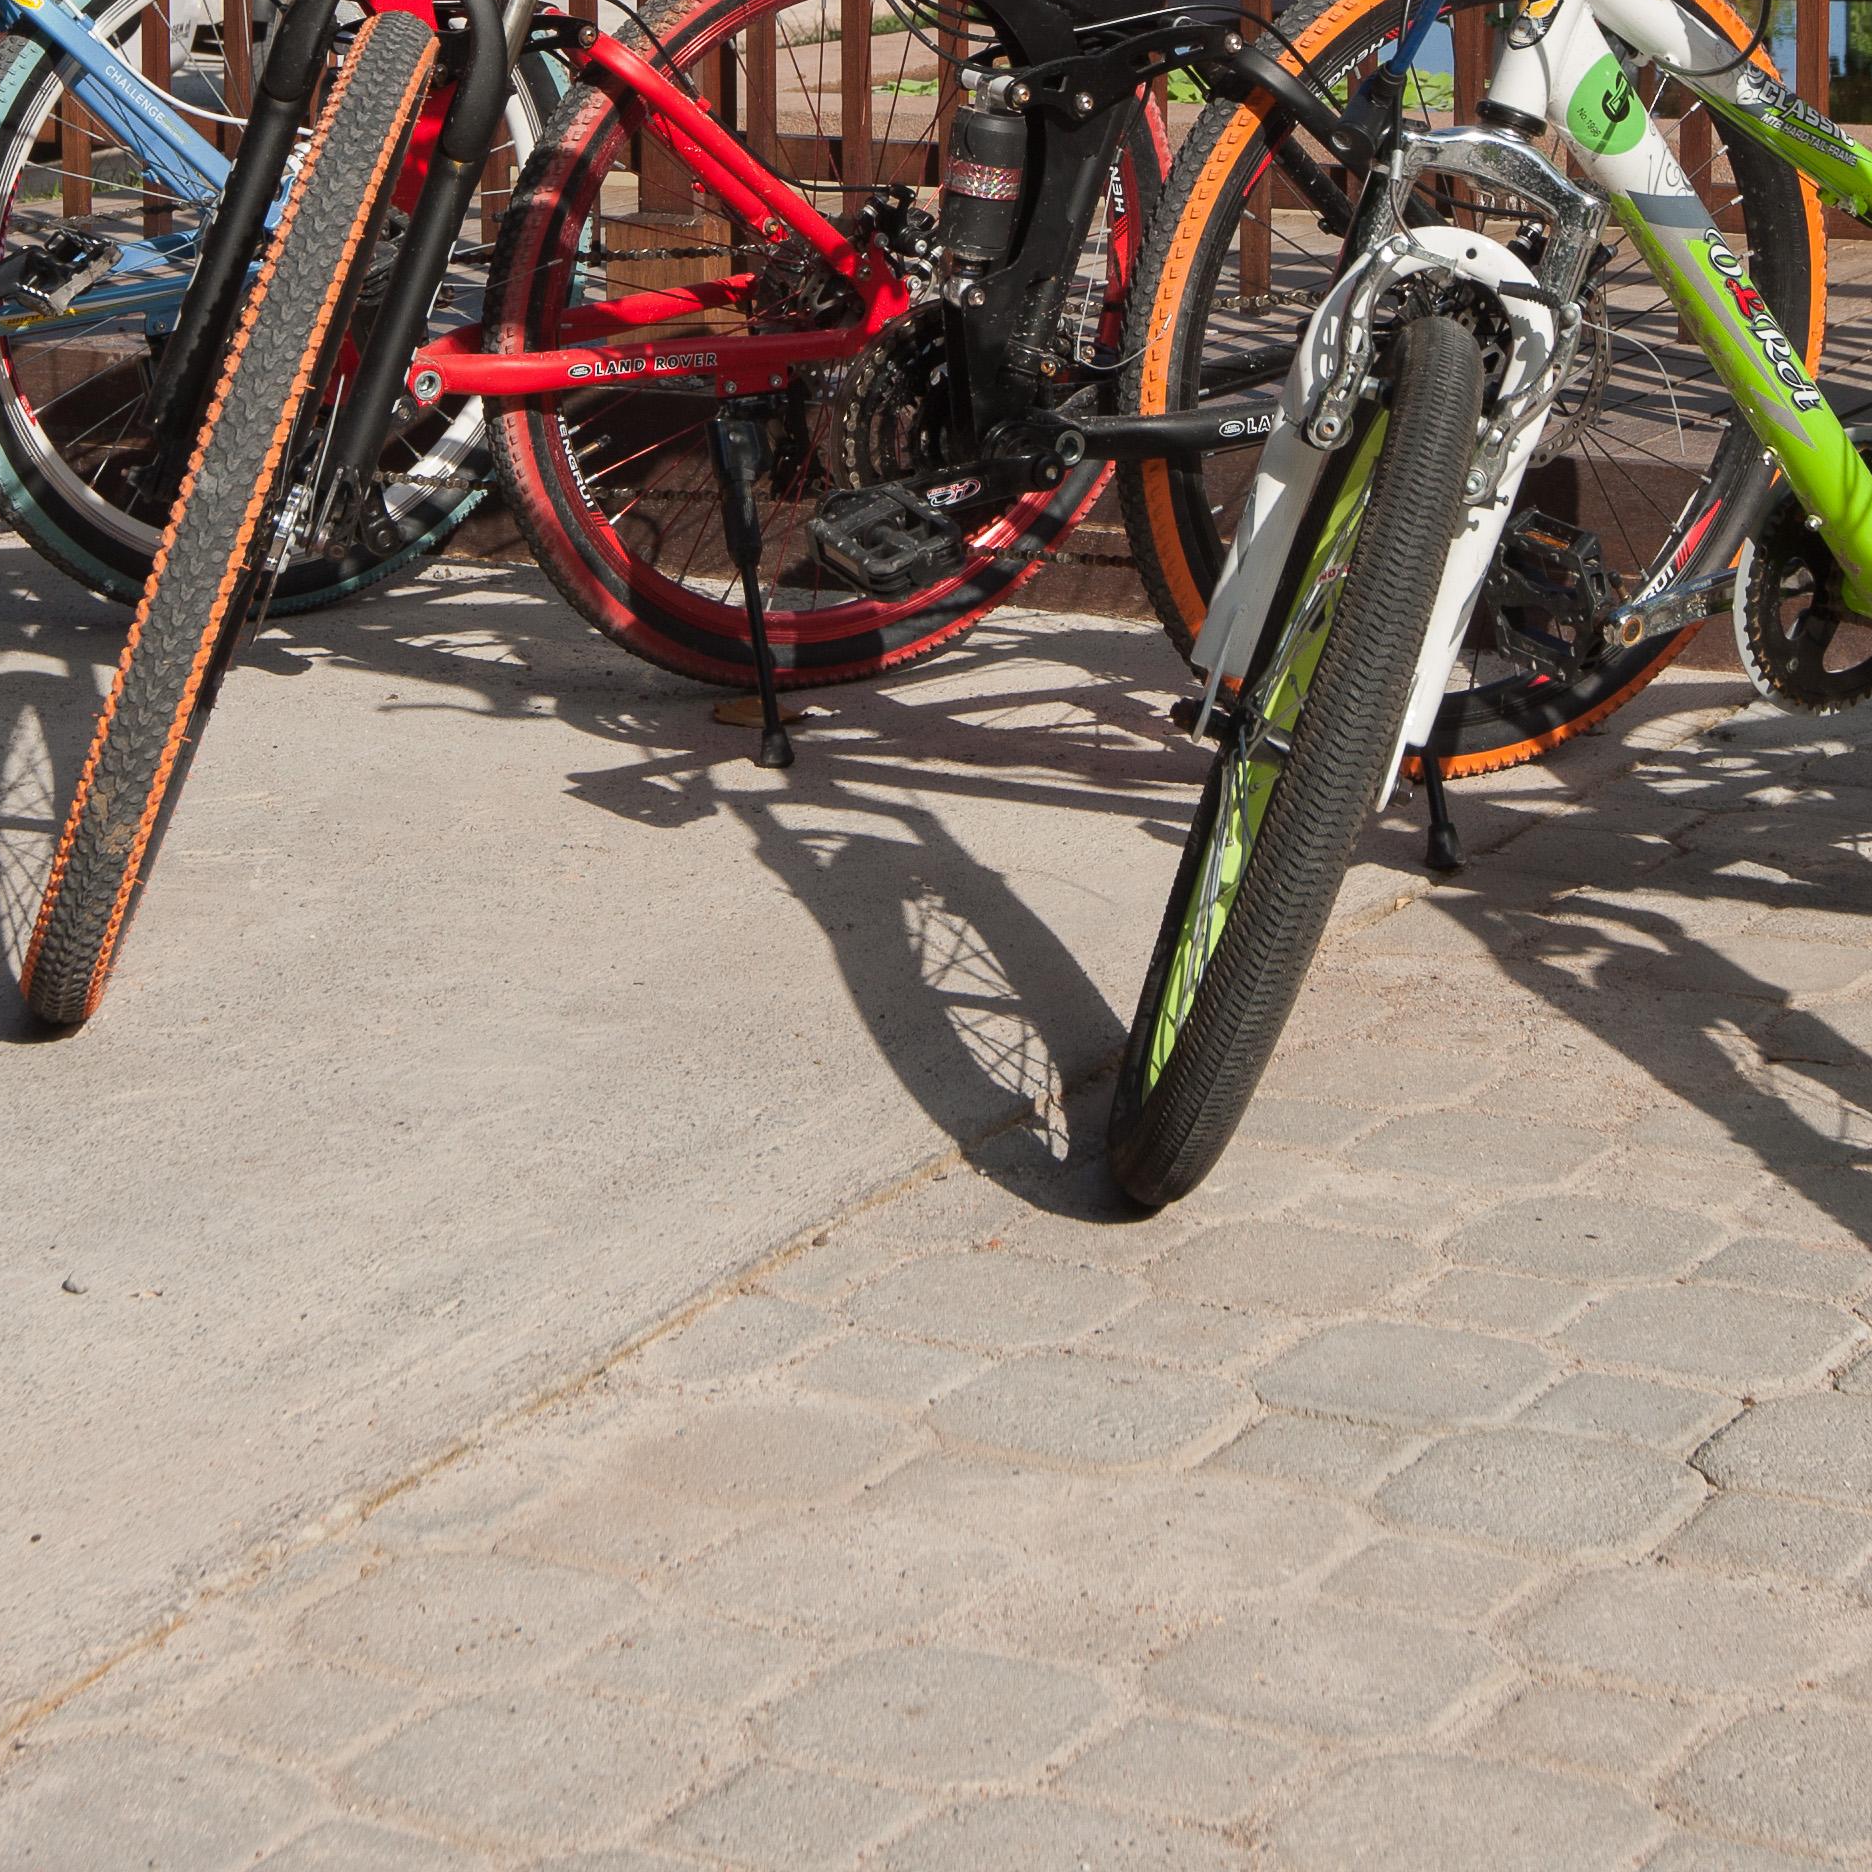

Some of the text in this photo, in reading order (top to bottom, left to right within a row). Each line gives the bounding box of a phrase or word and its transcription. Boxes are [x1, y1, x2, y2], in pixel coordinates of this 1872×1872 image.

[104, 65, 164, 125] CHALLENGE
[1758, 80, 1855, 148] CLASSIC
[1783, 122, 1809, 143] HARD
[1810, 134, 1828, 152] TAIL
[1828, 143, 1858, 167] FRAME
[594, 359, 646, 377] LAND
[654, 352, 718, 371] ROVER
[1247, 414, 1272, 434] LA
